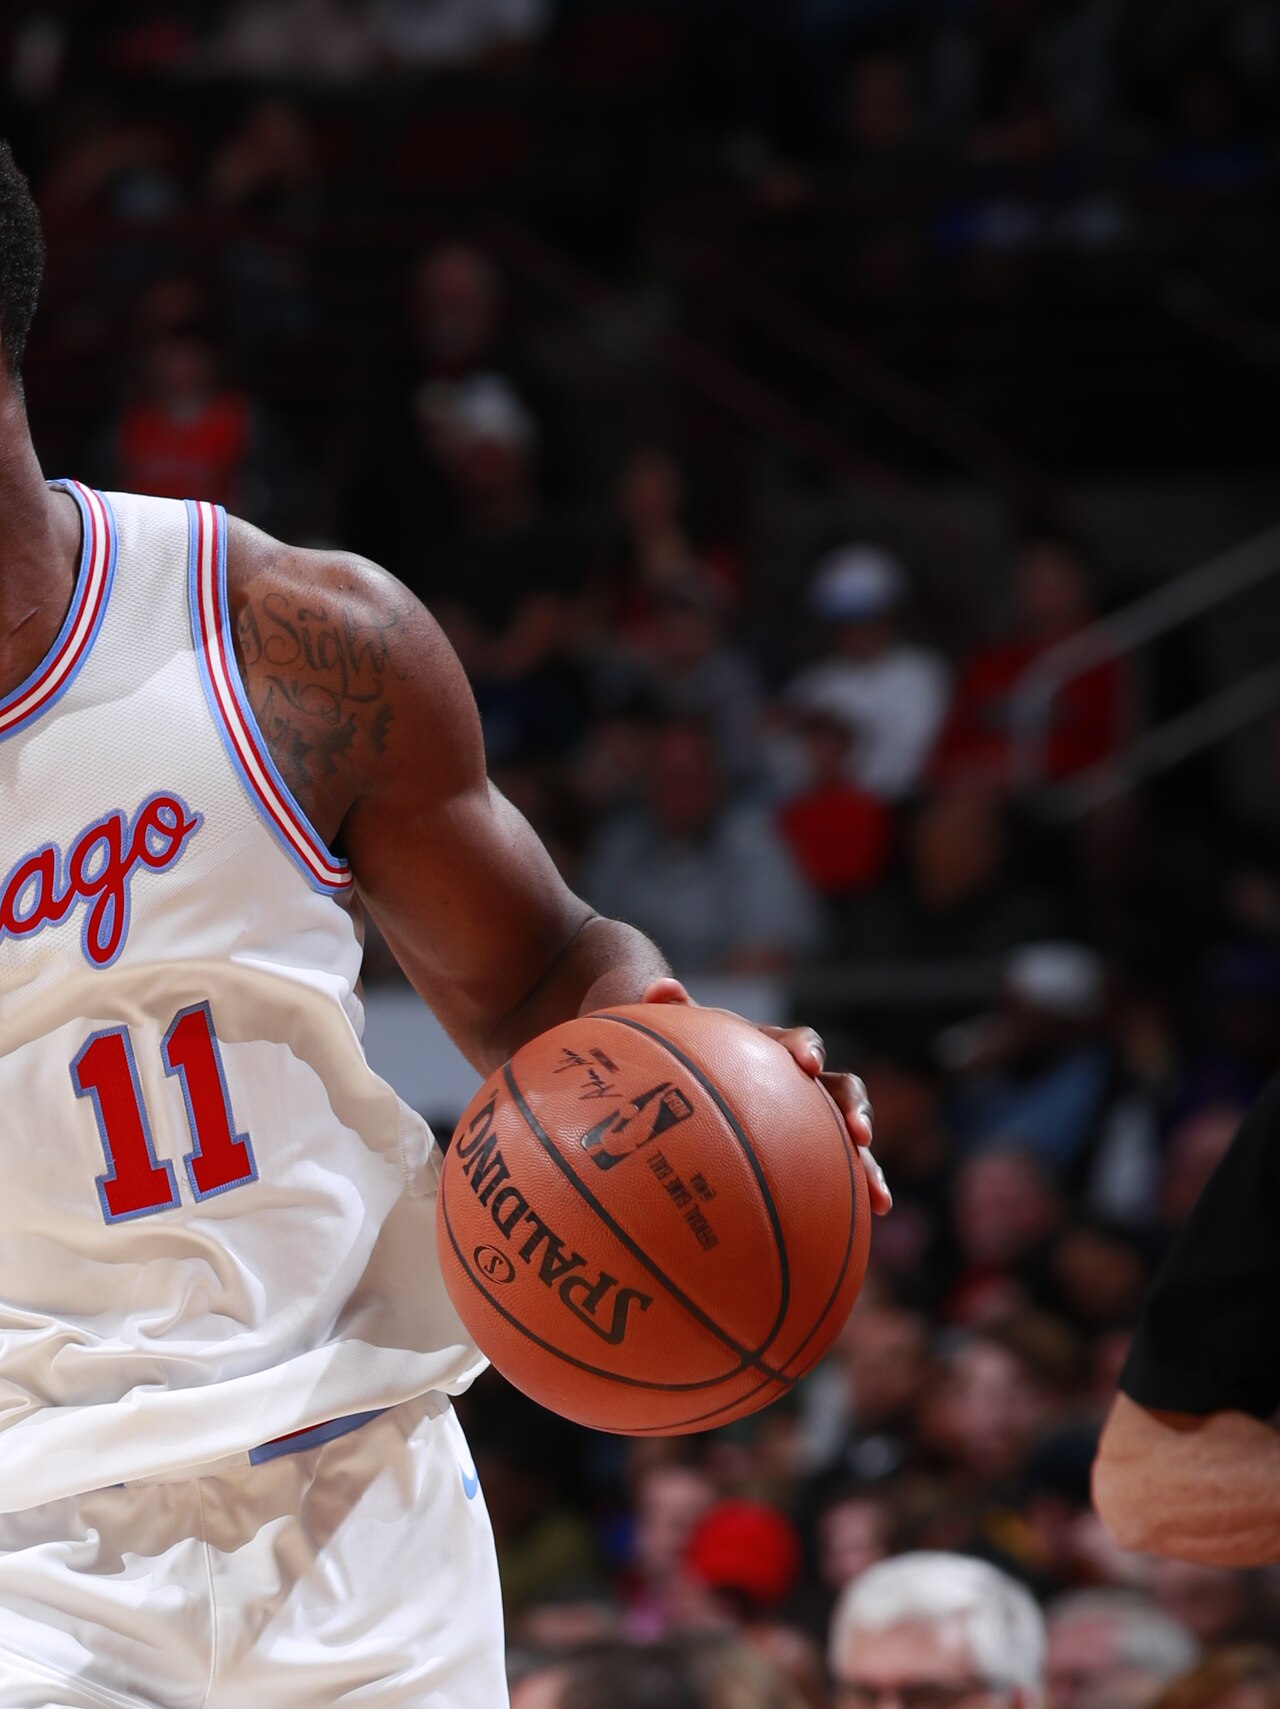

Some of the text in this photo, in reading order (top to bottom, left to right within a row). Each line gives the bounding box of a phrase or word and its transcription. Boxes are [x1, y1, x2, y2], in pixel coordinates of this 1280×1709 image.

[69, 1001, 260, 1226] 11
[646, 1149, 673, 1181] BALL
[455, 1098, 654, 1346] SPALDING
[662, 1176, 692, 1208] GAME
